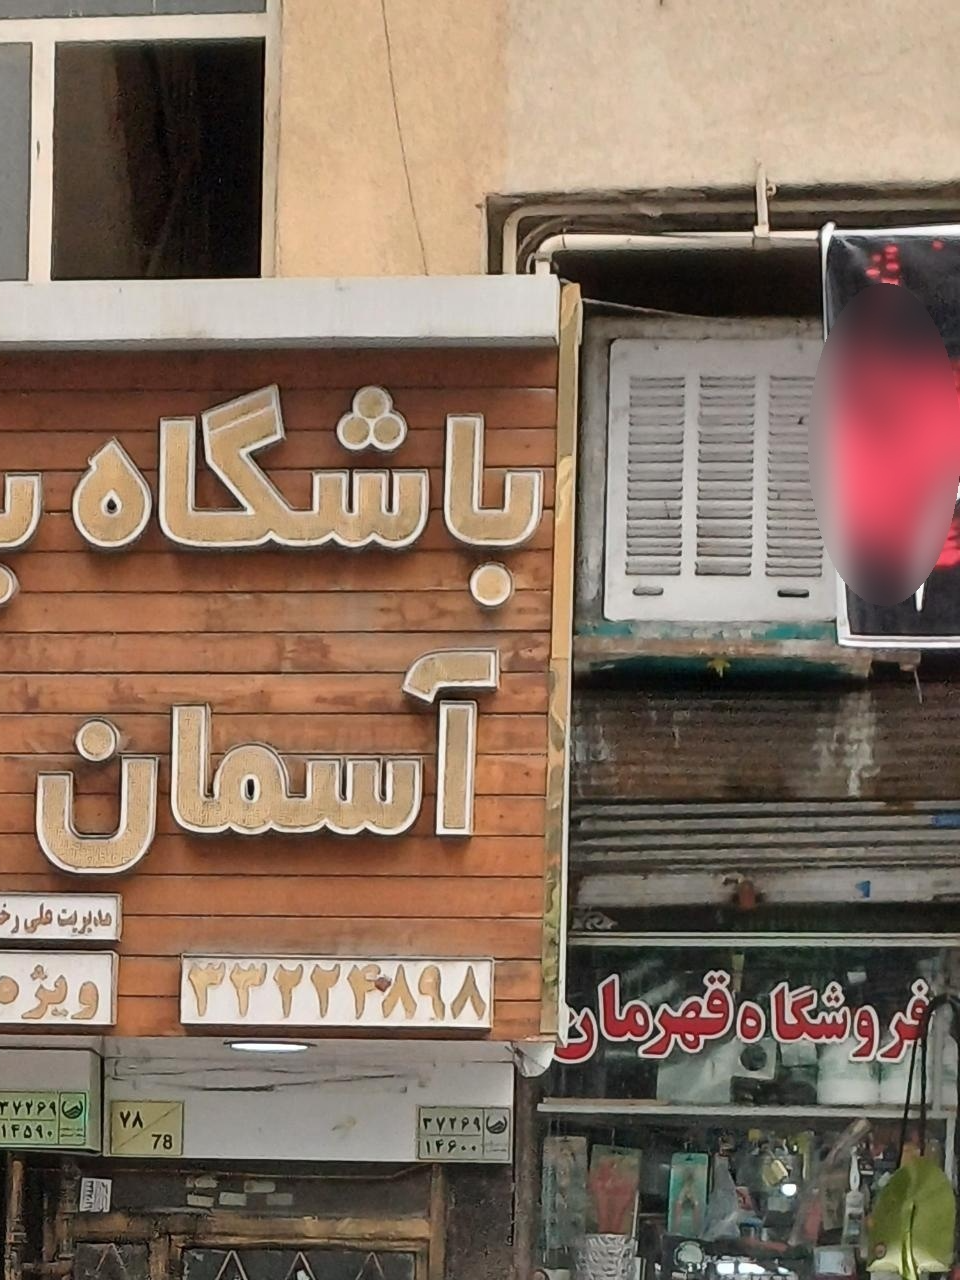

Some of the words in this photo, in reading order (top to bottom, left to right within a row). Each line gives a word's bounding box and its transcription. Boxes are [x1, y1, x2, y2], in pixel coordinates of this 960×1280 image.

[72, 384, 543, 606] باشگاه
[36, 648, 500, 873] آسمان
[188, 961, 487, 1021] ۳۳۲۲۴۸۹۸
[552, 969, 735, 1065] قهرمان
[735, 977, 934, 1064] فروشگاه
[0, 1123, 53, 1139] ۱۴۵۹۰
[119, 1110, 144, 1128] ۷۸
[151, 1133, 173, 1150] 78
[423, 1116, 481, 1133] ۳۷۲۶۹
